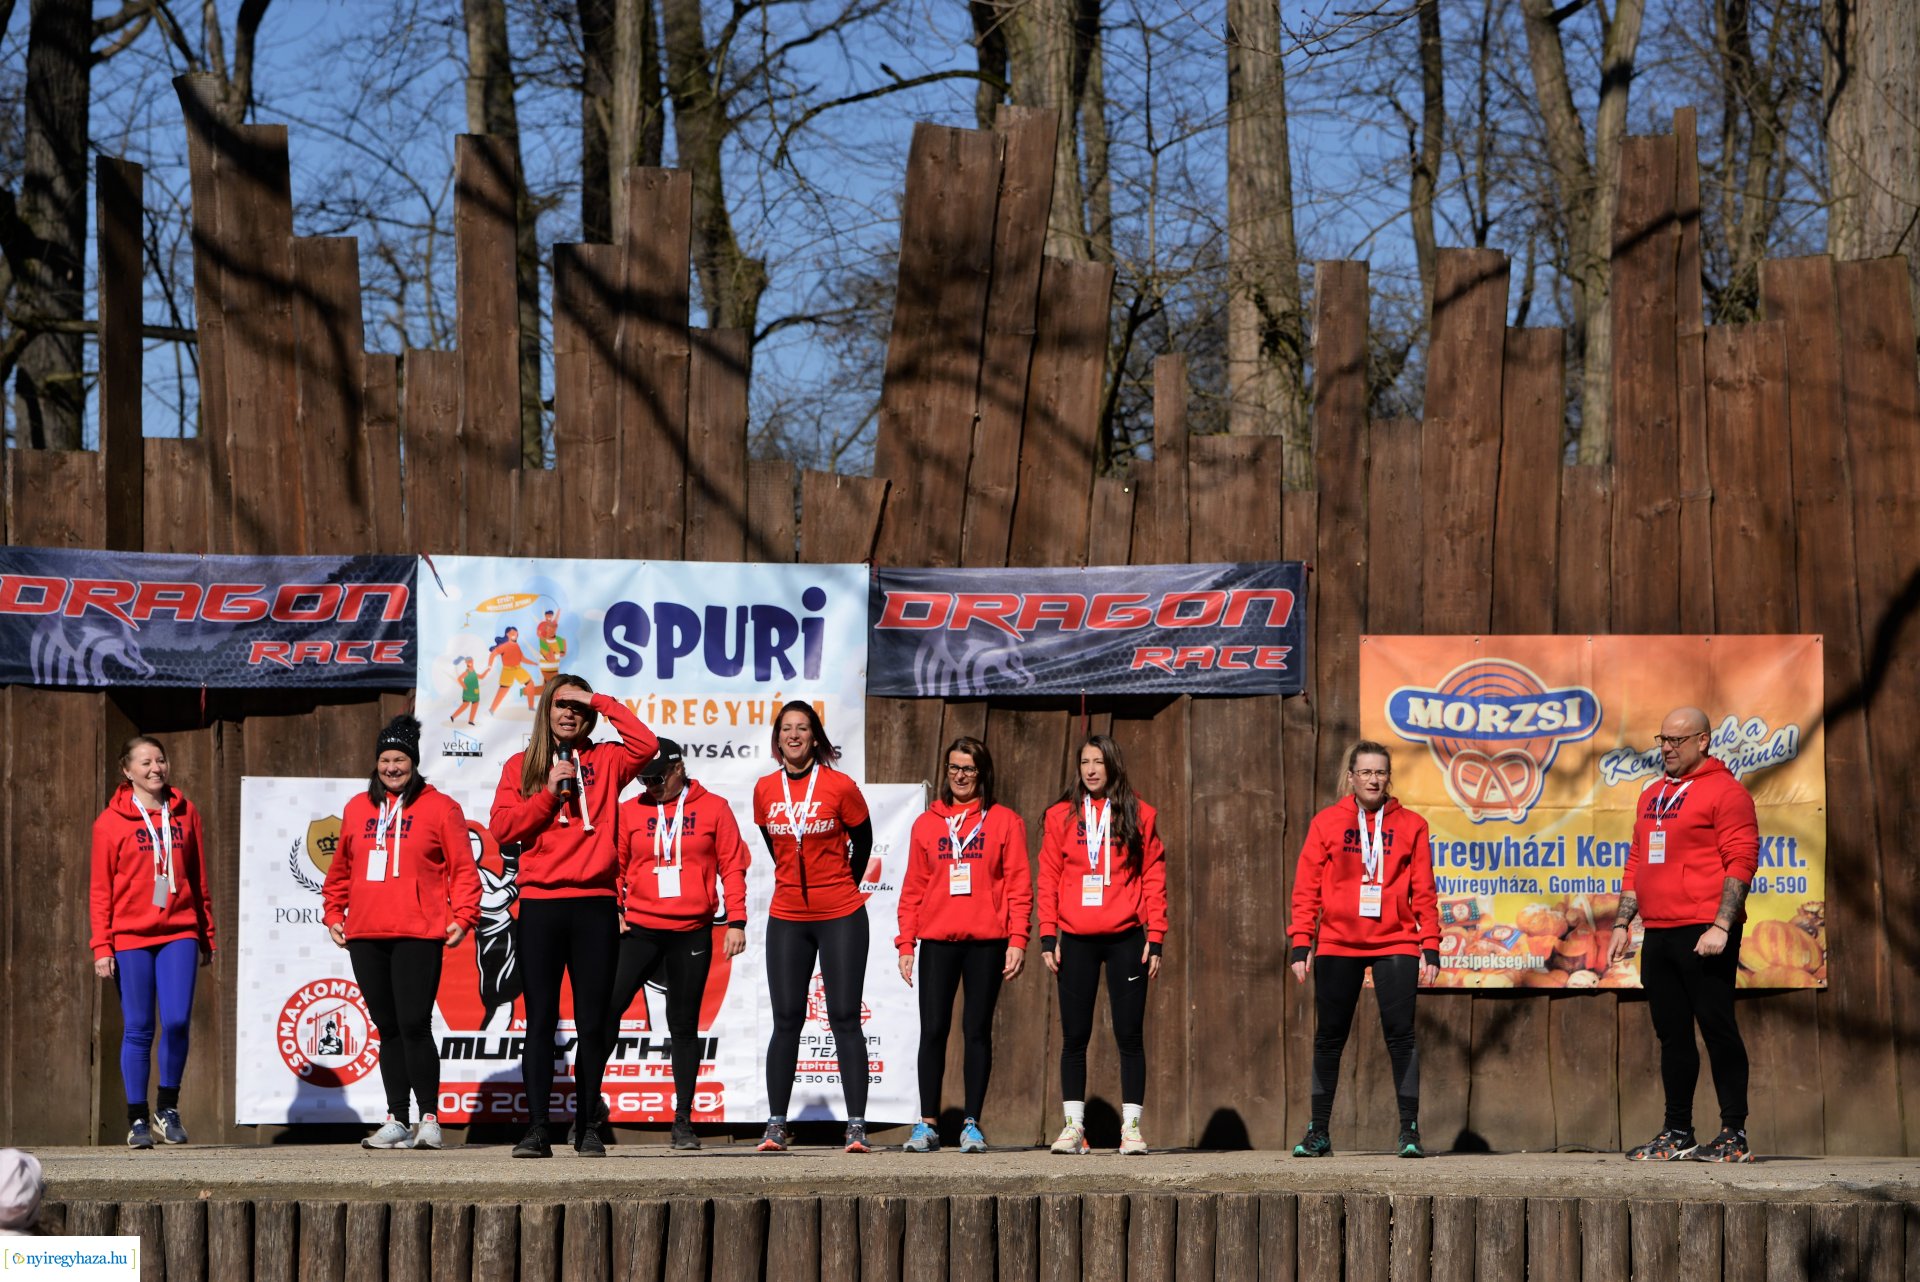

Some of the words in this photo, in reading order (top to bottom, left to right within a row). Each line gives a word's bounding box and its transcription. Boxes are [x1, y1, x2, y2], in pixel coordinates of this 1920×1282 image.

[0, 574, 409, 631] DRAGON
[874, 588, 1296, 642] DRAGON
[248, 640, 408, 669] RACE
[1130, 646, 1293, 675] RACE
[604, 691, 826, 727] YÍREGYHÁA
[1407, 697, 1582, 733] MORZSI
[443, 739, 483, 751] vektor
[1430, 835, 1564, 871] íregyházi
[1758, 836, 1806, 867] Kft.
[1436, 875, 1543, 895] Nyíregyháza,
[1549, 876, 1606, 893] Gomba
[1750, 876, 1807, 894] 08-590
[1440, 953, 1545, 969] orzsipekseg.hu
[806, 1075, 823, 1084] 30
[438, 1092, 483, 1113] 06
[617, 1092, 663, 1112] 62
